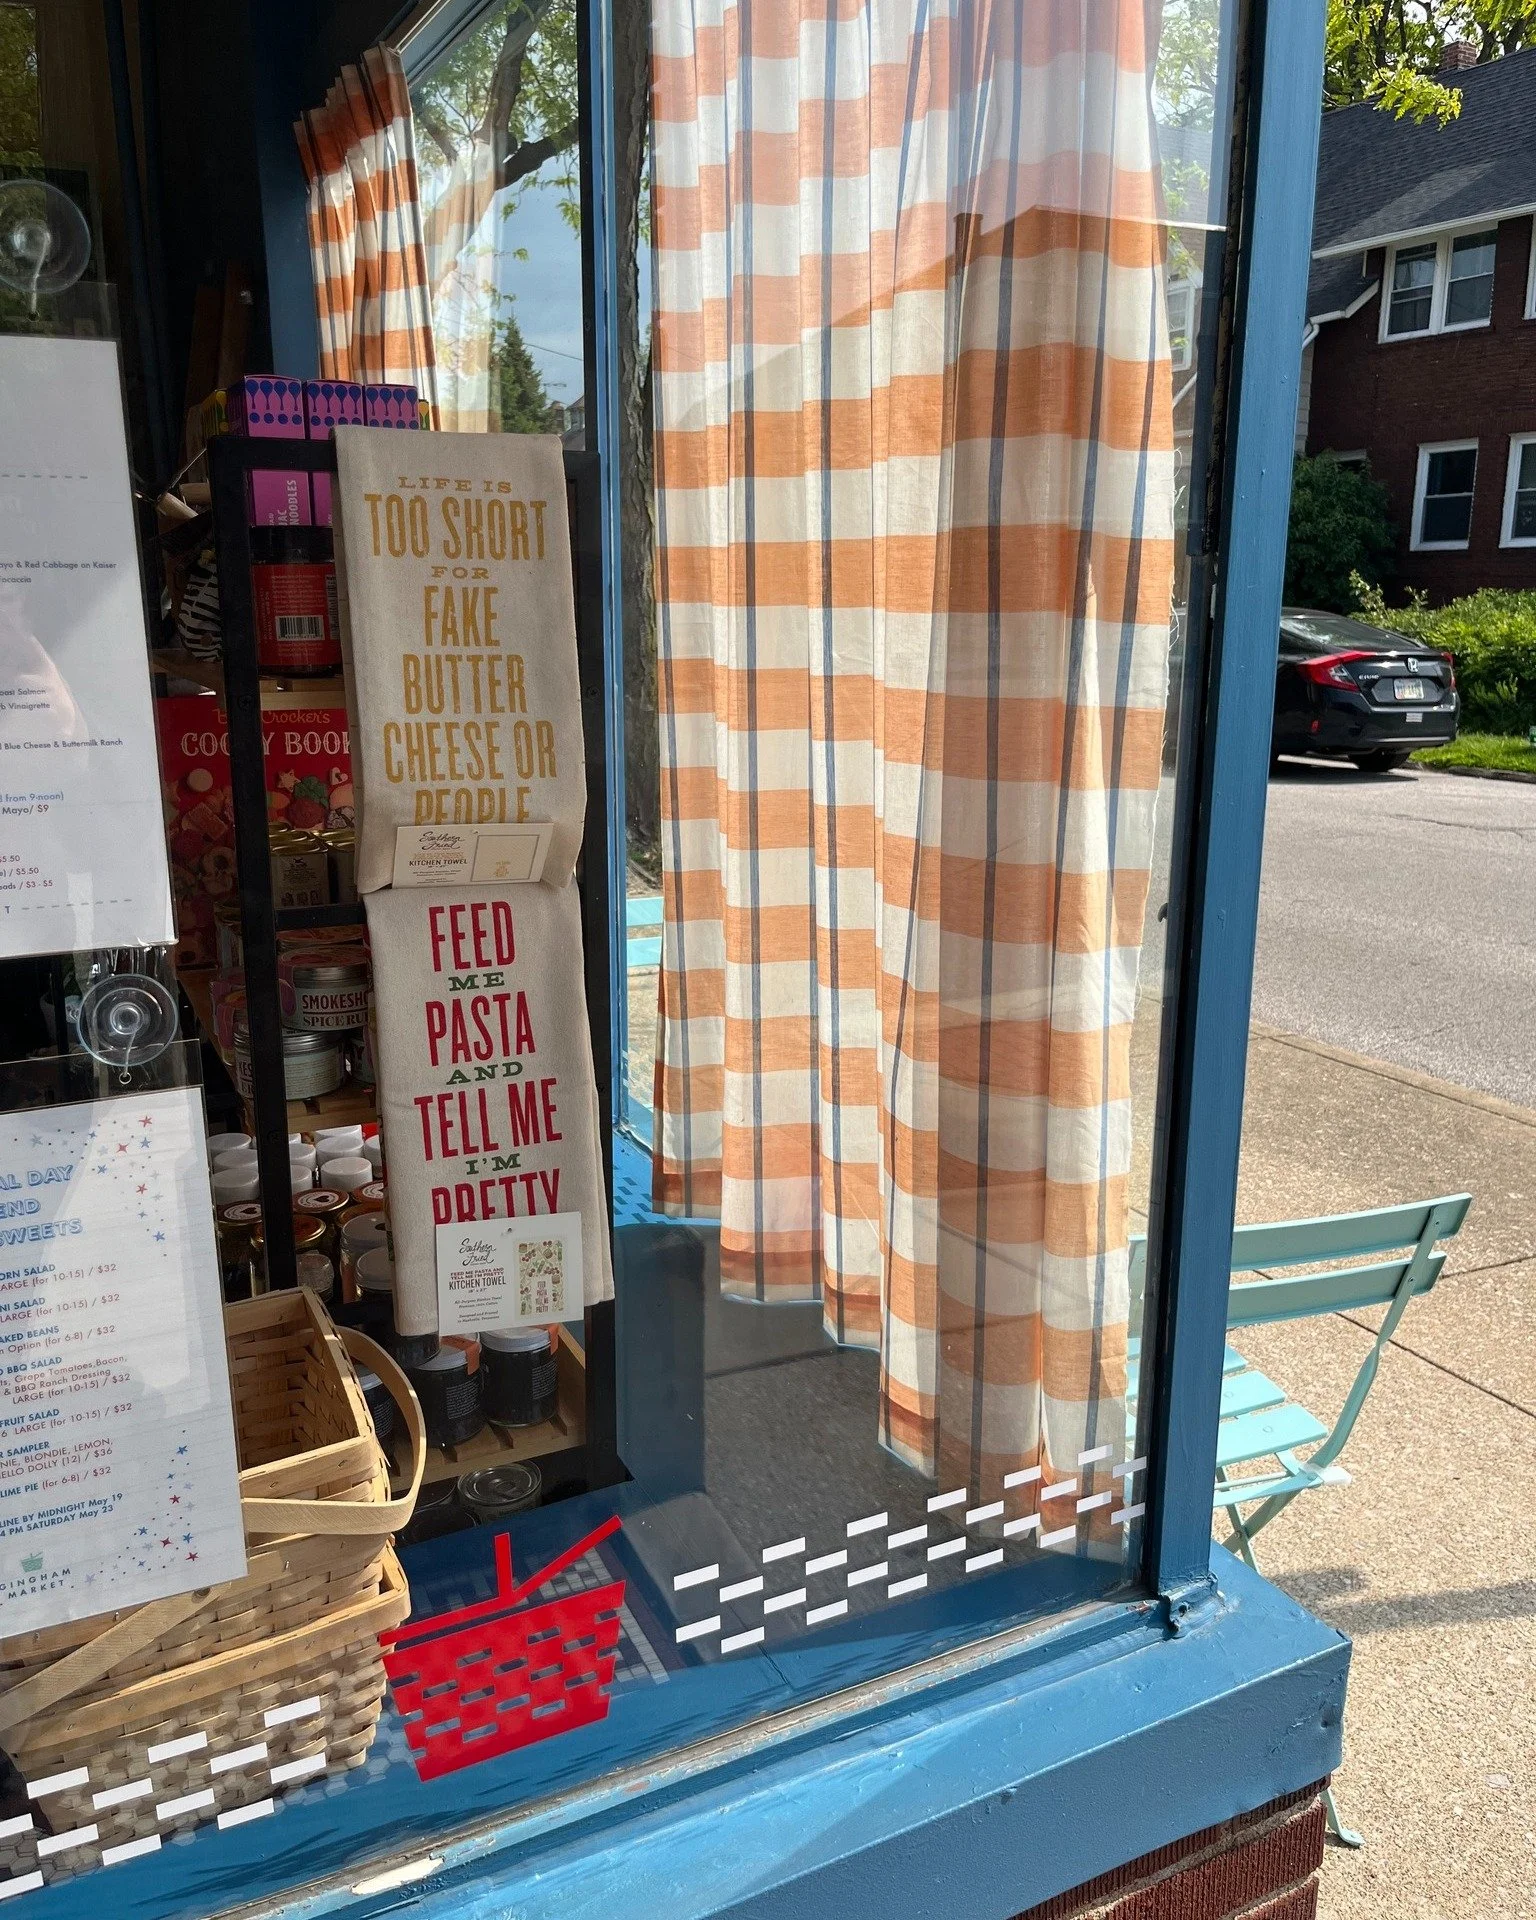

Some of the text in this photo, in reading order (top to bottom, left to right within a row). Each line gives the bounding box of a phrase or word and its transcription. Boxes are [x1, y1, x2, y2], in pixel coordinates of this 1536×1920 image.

[398, 476, 512, 494] LIFE IS
[364, 493, 548, 561] TOO SHORT
[24, 560, 40, 568] Red
[42, 560, 78, 570] Cabbage
[92, 560, 117, 568] Kaiser
[431, 566, 490, 580] FOR
[424, 585, 500, 647] FAKE
[402, 654, 528, 714] BUTTER
[9, 702, 50, 712] Vinaigrette
[262, 709, 332, 724] Crocker's
[4, 741, 21, 750] Blue
[24, 740, 52, 749] Cheese
[62, 739, 98, 748] Buttermilk
[100, 738, 124, 746] Ranch
[180, 732, 275, 756] COOY
[383, 720, 558, 784] CHEESE OR
[6, 794, 26, 802] from
[37, 804, 50, 814] $9
[16, 866, 40, 876] $5.50
[26, 880, 36, 889] $3
[43, 879, 53, 888] $5
[428, 900, 516, 972] FEED
[448, 971, 506, 992] ME
[303, 1015, 344, 1027] SPICE
[426, 990, 536, 1066] PASTA
[446, 1061, 524, 1085] AND
[414, 1078, 563, 1162] TELL ME
[26, 1164, 74, 1188] DAY
[466, 1153, 522, 1176] I'M
[431, 1168, 560, 1225] PRETTY
[24, 1263, 56, 1278] SALAD
[98, 1263, 117, 1274] $32
[448, 1278, 480, 1290] KITCHEN
[482, 1276, 506, 1287] TOWEL
[0, 1310, 33, 1323] LARGE
[101, 1293, 120, 1304] $32
[14, 1297, 46, 1310] SALAD
[8, 1342, 42, 1354] Option
[96, 1324, 116, 1336] $32
[27, 1325, 60, 1338] BEANS
[7, 1364, 28, 1374] BBQ
[30, 1356, 62, 1370] SALAD
[4, 1368, 112, 1396] & BBQ Ranch Dressing
[12, 1390, 45, 1404] LARGE
[68, 1380, 100, 1393] 10-15)
[112, 1373, 132, 1384] $32
[14, 1372, 45, 1384] Grape
[0, 1408, 60, 1428] FRUIT SALAD
[14, 1421, 47, 1435] LARGE
[70, 1410, 101, 1424] 10-15)
[114, 1402, 133, 1414] $32
[7, 1441, 50, 1458] SAMPLER
[24, 1446, 71, 1463] BLONDIE,
[74, 1437, 114, 1452] LEMON,
[28, 1460, 58, 1473] DOLLY
[62, 1454, 81, 1467] (12)
[93, 1447, 113, 1458] $36
[0, 1486, 22, 1498] LIME
[24, 1482, 40, 1493] PIE
[61, 1473, 80, 1484] 6-8)
[92, 1466, 112, 1478] $32
[22, 1514, 34, 1524] BY
[37, 1501, 86, 1520] MIDNIGHT
[88, 1498, 108, 1508] May
[112, 1492, 124, 1502] 19
[9, 1526, 24, 1536] PM
[26, 1513, 76, 1532] SATURDAY
[78, 1509, 99, 1520] May
[102, 1504, 114, 1514] 23
[0, 1568, 72, 1592] GINGHAM
[8, 1580, 64, 1600] MARKET
